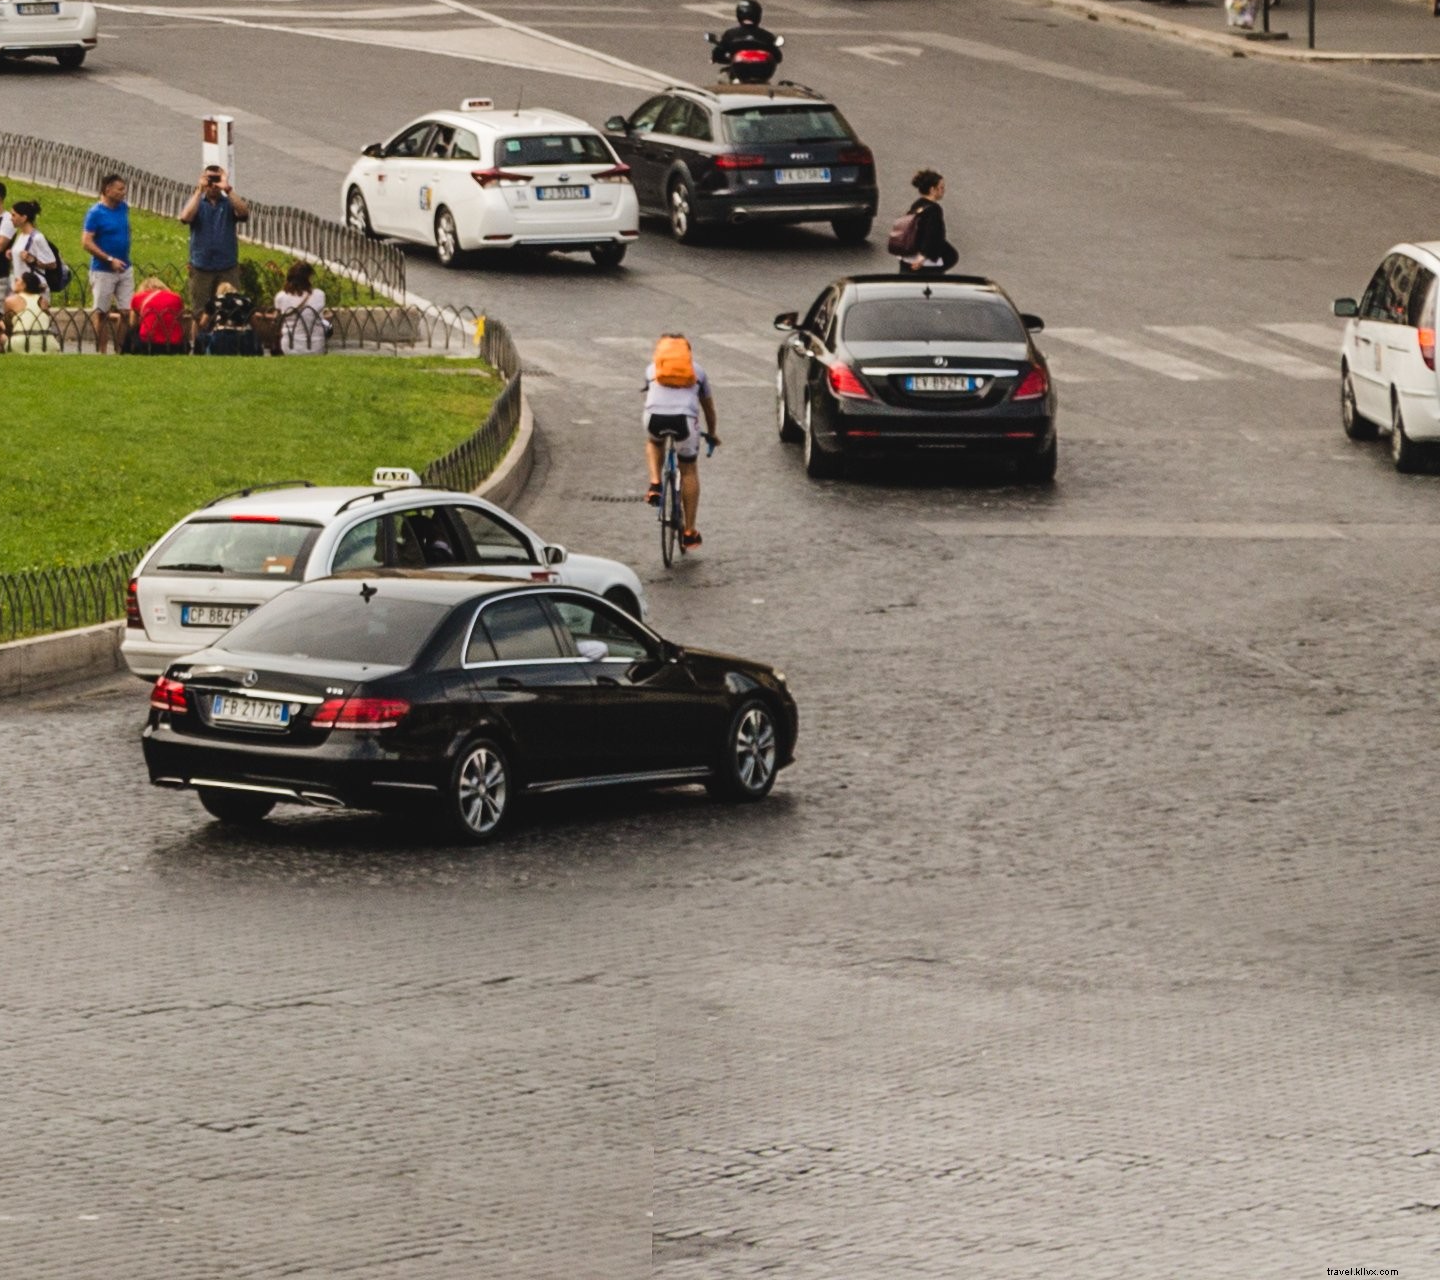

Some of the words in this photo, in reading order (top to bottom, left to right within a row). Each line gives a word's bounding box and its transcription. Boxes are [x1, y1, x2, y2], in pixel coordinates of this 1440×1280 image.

[377, 471, 410, 481] TAXI
[190, 607, 205, 622] CP
[222, 698, 238, 715] FB
